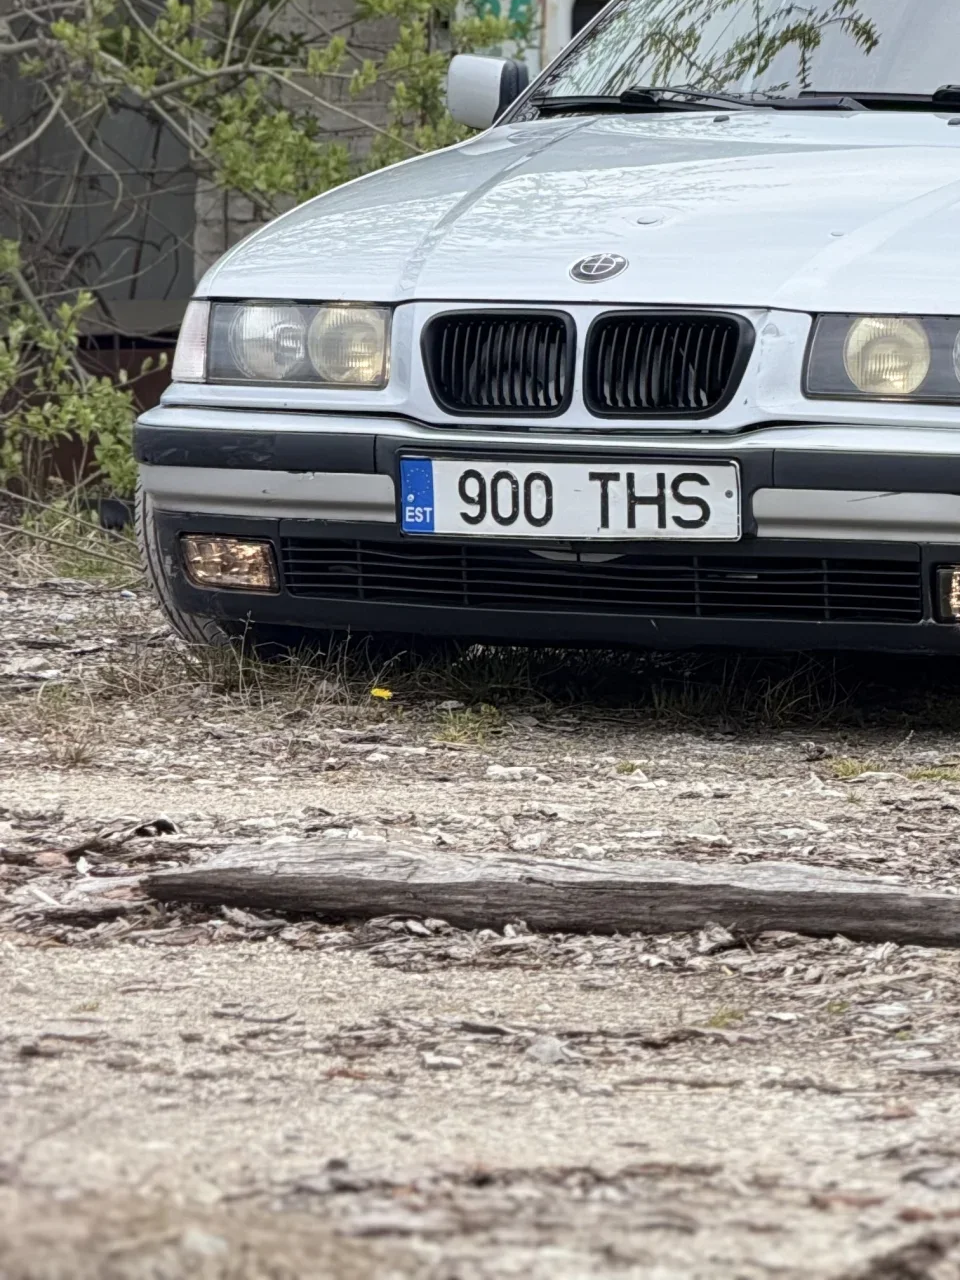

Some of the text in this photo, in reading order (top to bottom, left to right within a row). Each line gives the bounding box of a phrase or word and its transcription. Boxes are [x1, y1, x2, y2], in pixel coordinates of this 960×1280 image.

[405, 505, 433, 523] EST
[458, 468, 711, 529] 900 THS
